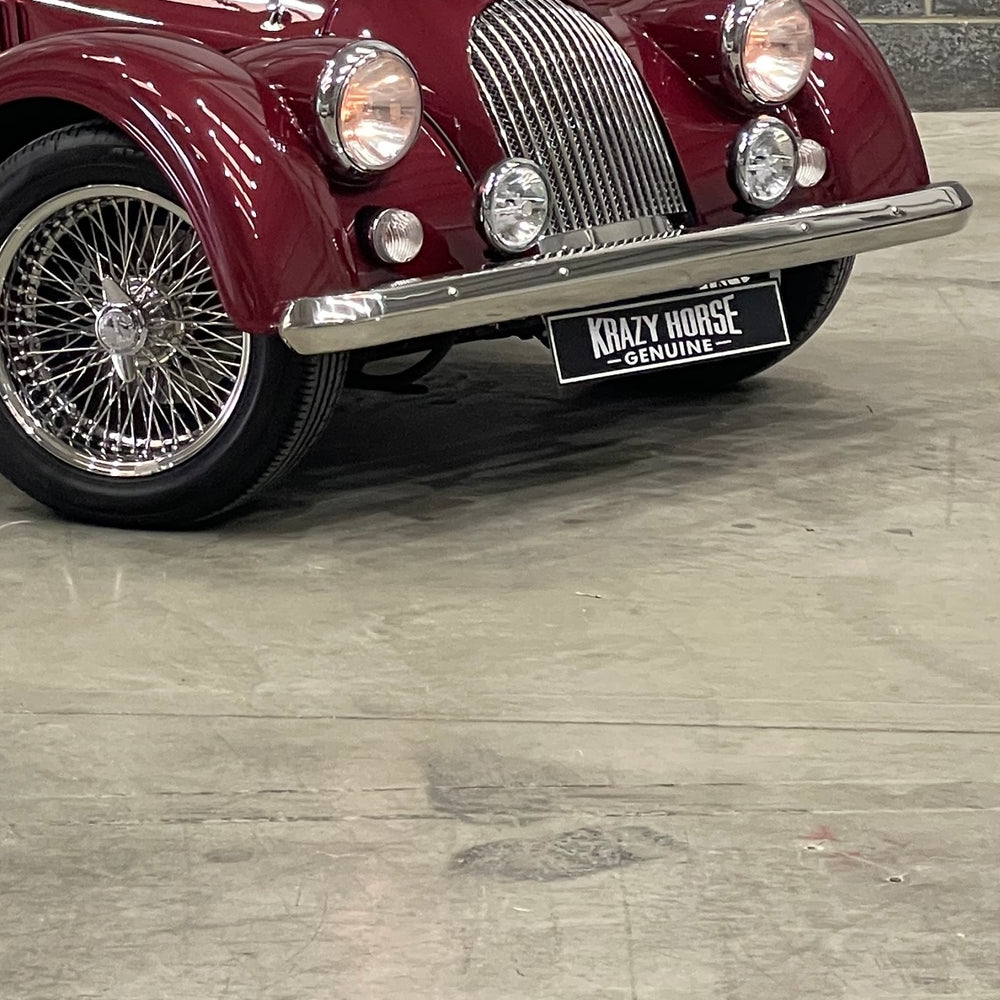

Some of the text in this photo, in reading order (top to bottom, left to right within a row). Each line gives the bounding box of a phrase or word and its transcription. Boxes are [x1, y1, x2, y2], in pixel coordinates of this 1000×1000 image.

[587, 294, 743, 359] KRAZY HORSE
[624, 339, 714, 366] GENUINE
